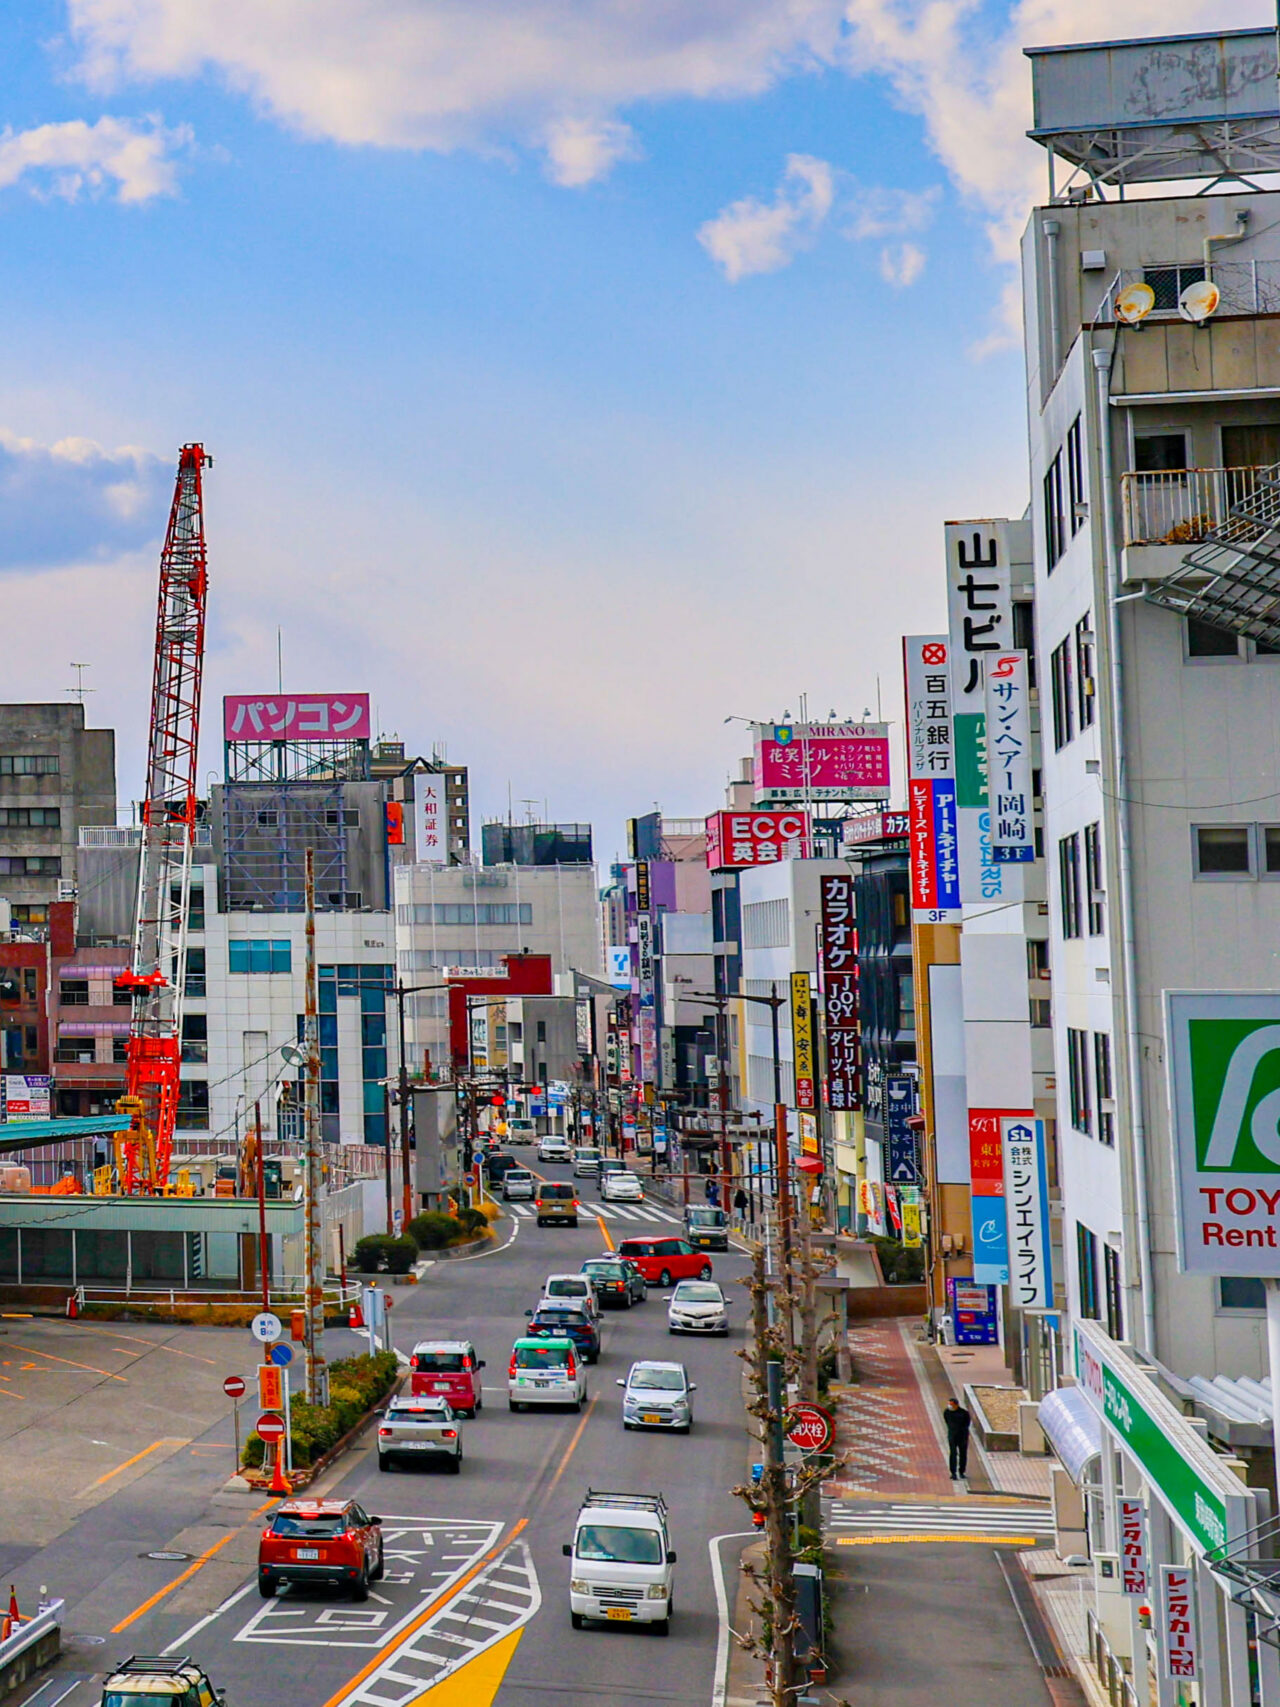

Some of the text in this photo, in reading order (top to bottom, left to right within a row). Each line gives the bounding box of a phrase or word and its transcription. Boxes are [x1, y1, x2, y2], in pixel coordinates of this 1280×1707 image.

[231, 701, 363, 733] パソコン
[809, 727, 865, 736] MIRANO
[924, 674, 950, 771] 百五銀行
[780, 764, 822, 779] ミラノ
[992, 682, 1027, 840] サン・ヘアー岡崎
[423, 786, 438, 847] 大和証券
[731, 816, 803, 840] ECC
[935, 793, 957, 895] アートネイチャー
[825, 879, 852, 969] カラオケ
[928, 910, 948, 922] 3F
[828, 983, 842, 1025] JOY
[840, 975, 855, 1018] JOY
[830, 1031, 845, 1108] ダーツ・卓球
[843, 1031, 857, 1108] ビリヤード
[889, 1102, 900, 1160] おにぎり
[1010, 1129, 1031, 1141] SL
[1012, 1170, 1038, 1305] シンエイライフ
[1202, 1221, 1278, 1248] Rent
[1123, 1502, 1142, 1569] レンタカー
[1126, 1583, 1144, 1593] IN
[1167, 1572, 1192, 1648] レンタカー
[1172, 1665, 1194, 1676] IN
